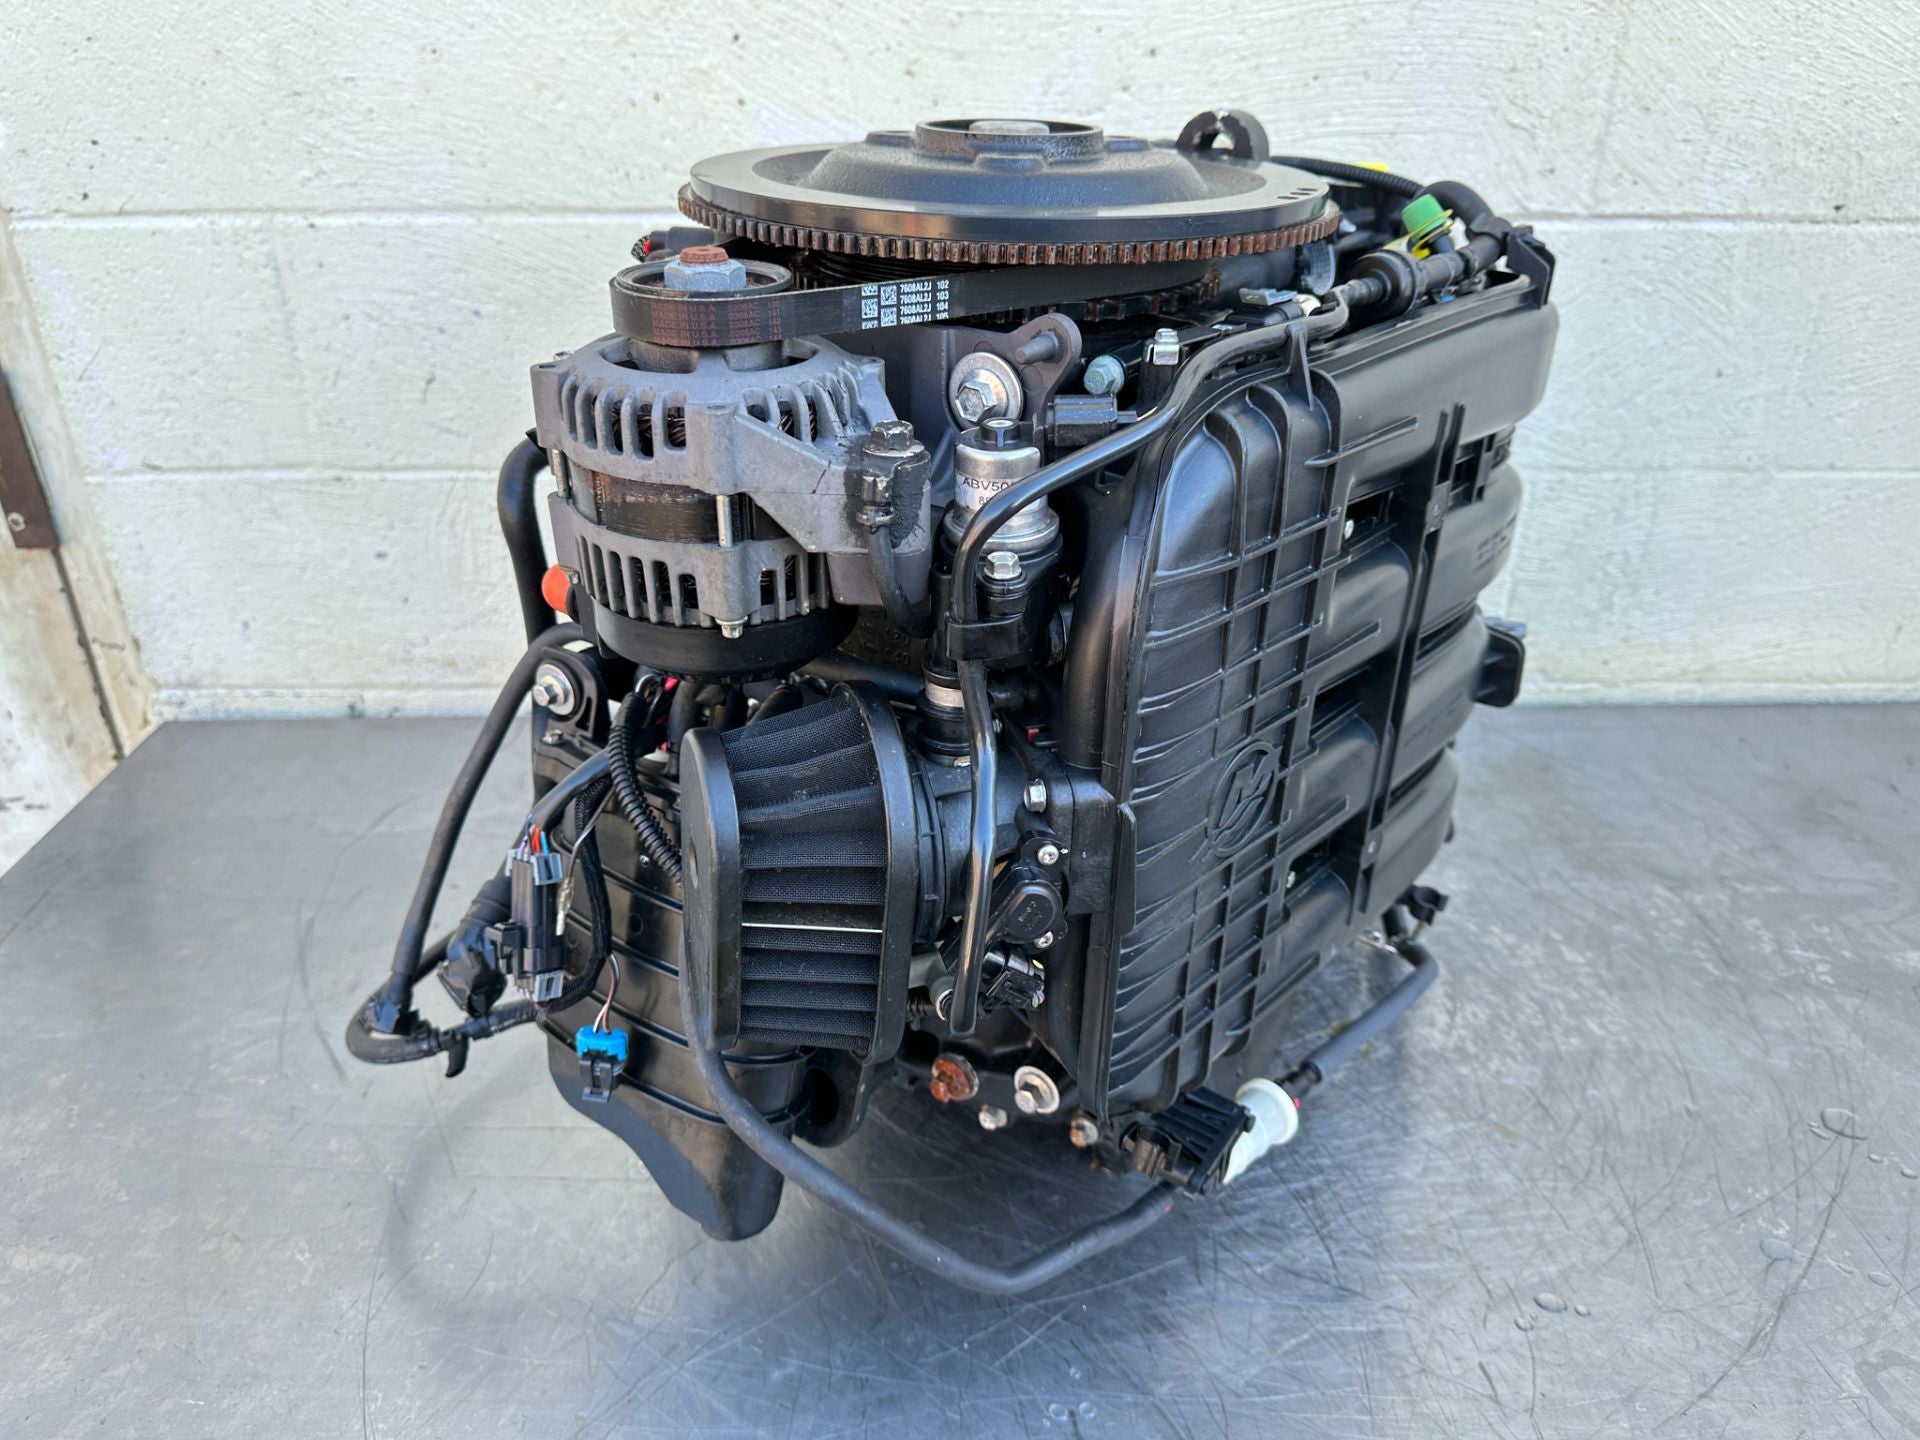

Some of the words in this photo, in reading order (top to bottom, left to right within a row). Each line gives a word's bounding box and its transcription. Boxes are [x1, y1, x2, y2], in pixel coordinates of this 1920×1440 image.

[936, 280, 949, 290] 102
[936, 290, 949, 300] 103
[936, 301, 949, 311] 104
[963, 477, 1014, 492] ABV50
